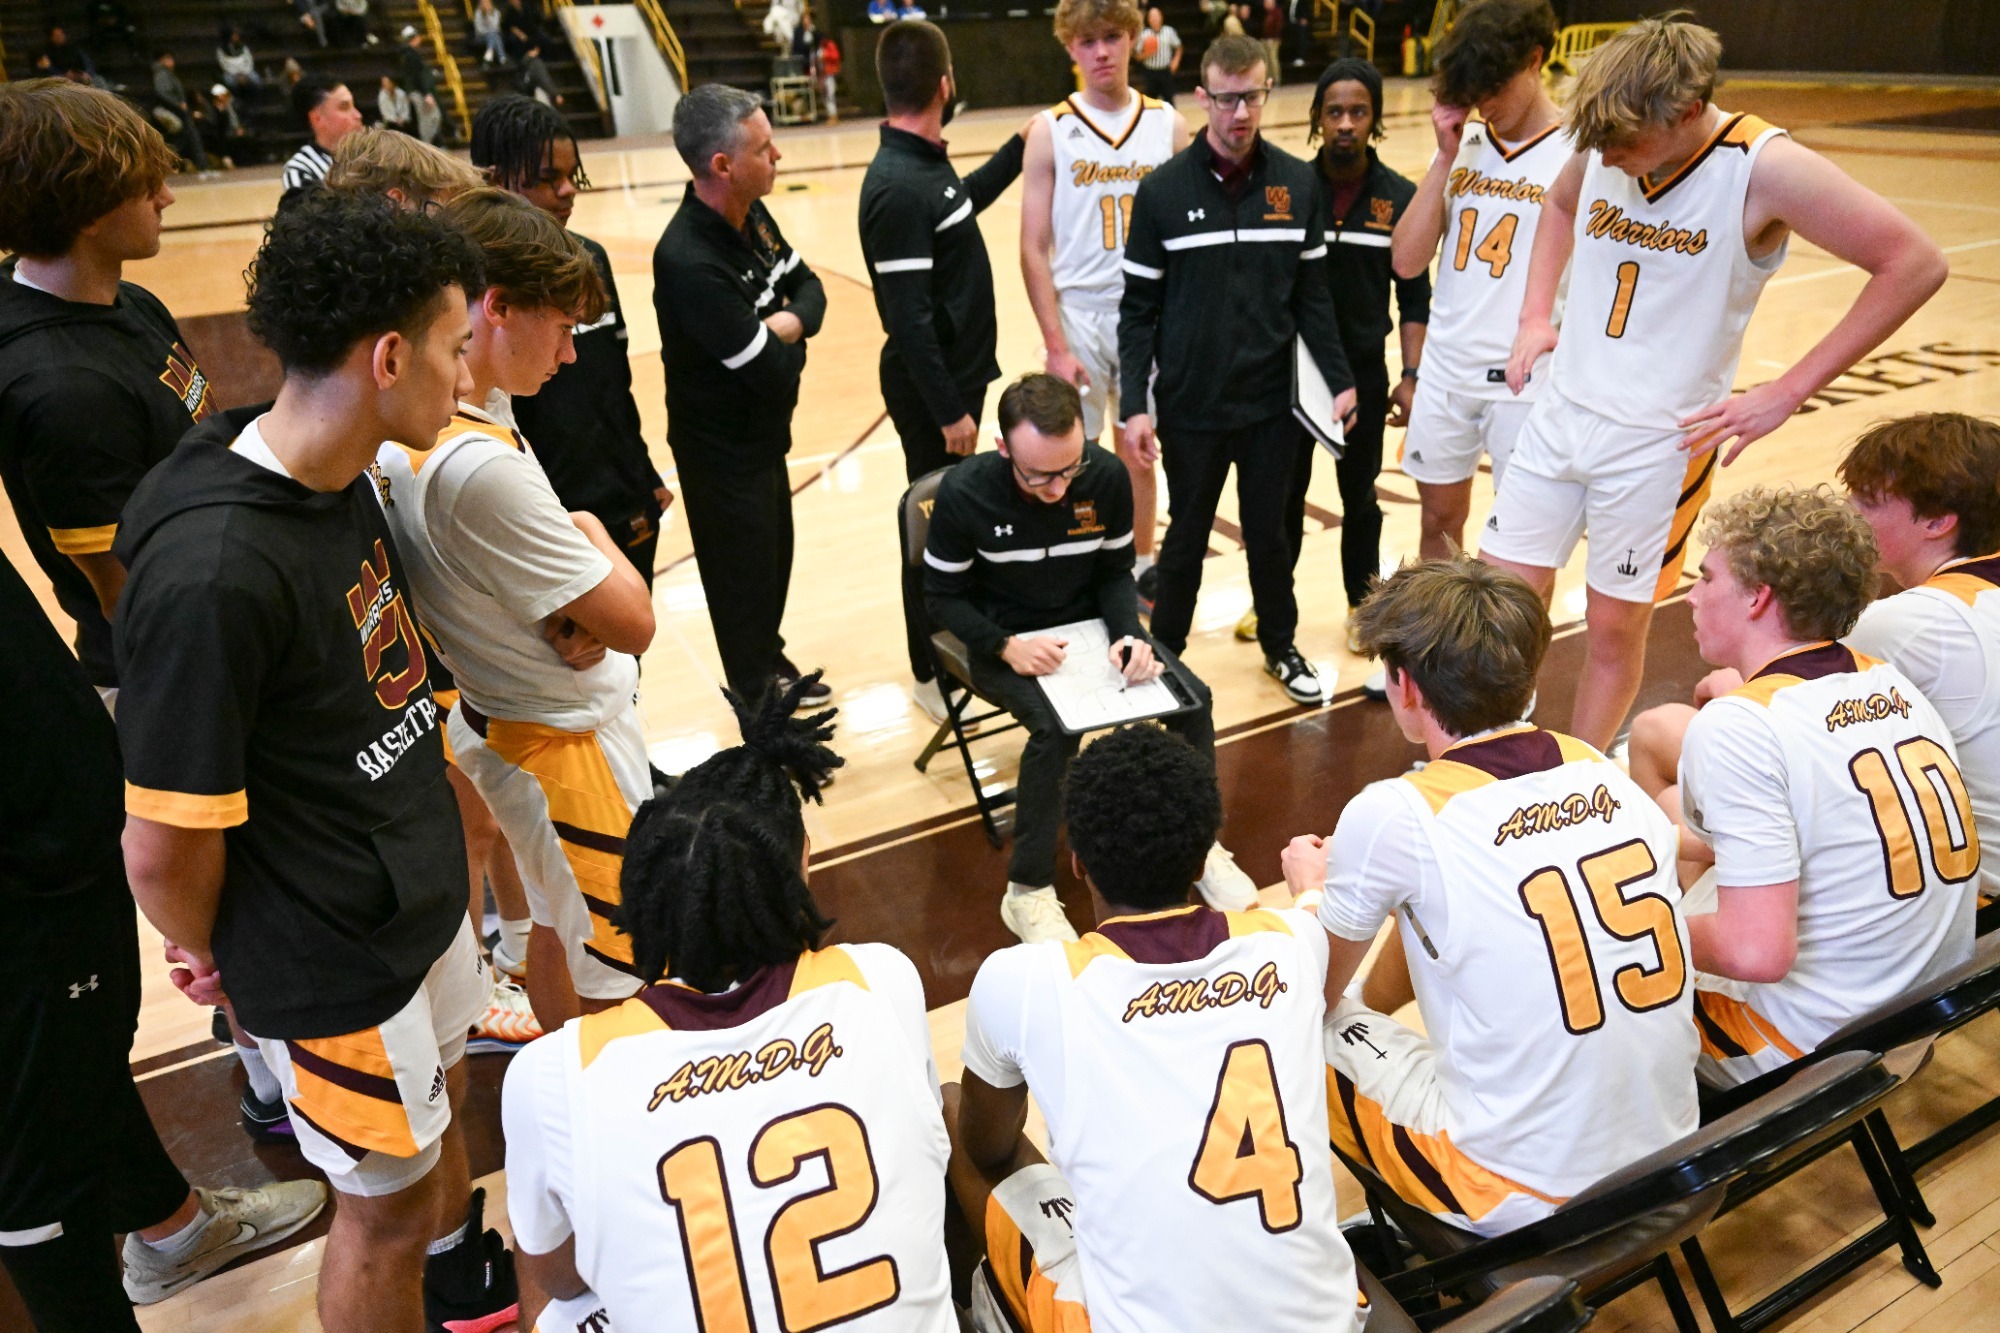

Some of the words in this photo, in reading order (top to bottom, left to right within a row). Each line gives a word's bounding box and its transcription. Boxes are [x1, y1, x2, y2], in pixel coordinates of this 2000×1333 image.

[1071, 159, 1154, 187] Warrior
[1449, 166, 1547, 205] Warrior
[1453, 207, 1520, 279] 14
[1586, 198, 1709, 256] Warriors
[1605, 260, 1640, 339] 1
[1826, 692, 1913, 733] A.M.D.G.
[1494, 783, 1622, 847] A.M.D.G.
[1847, 734, 1981, 904] 10
[1517, 837, 1687, 1036] 15
[1121, 960, 1289, 1024] A.M.D.G.
[646, 1022, 844, 1112] A.M.D.G.
[1187, 1037, 1304, 1235] 4
[656, 1101, 902, 1333] 12
